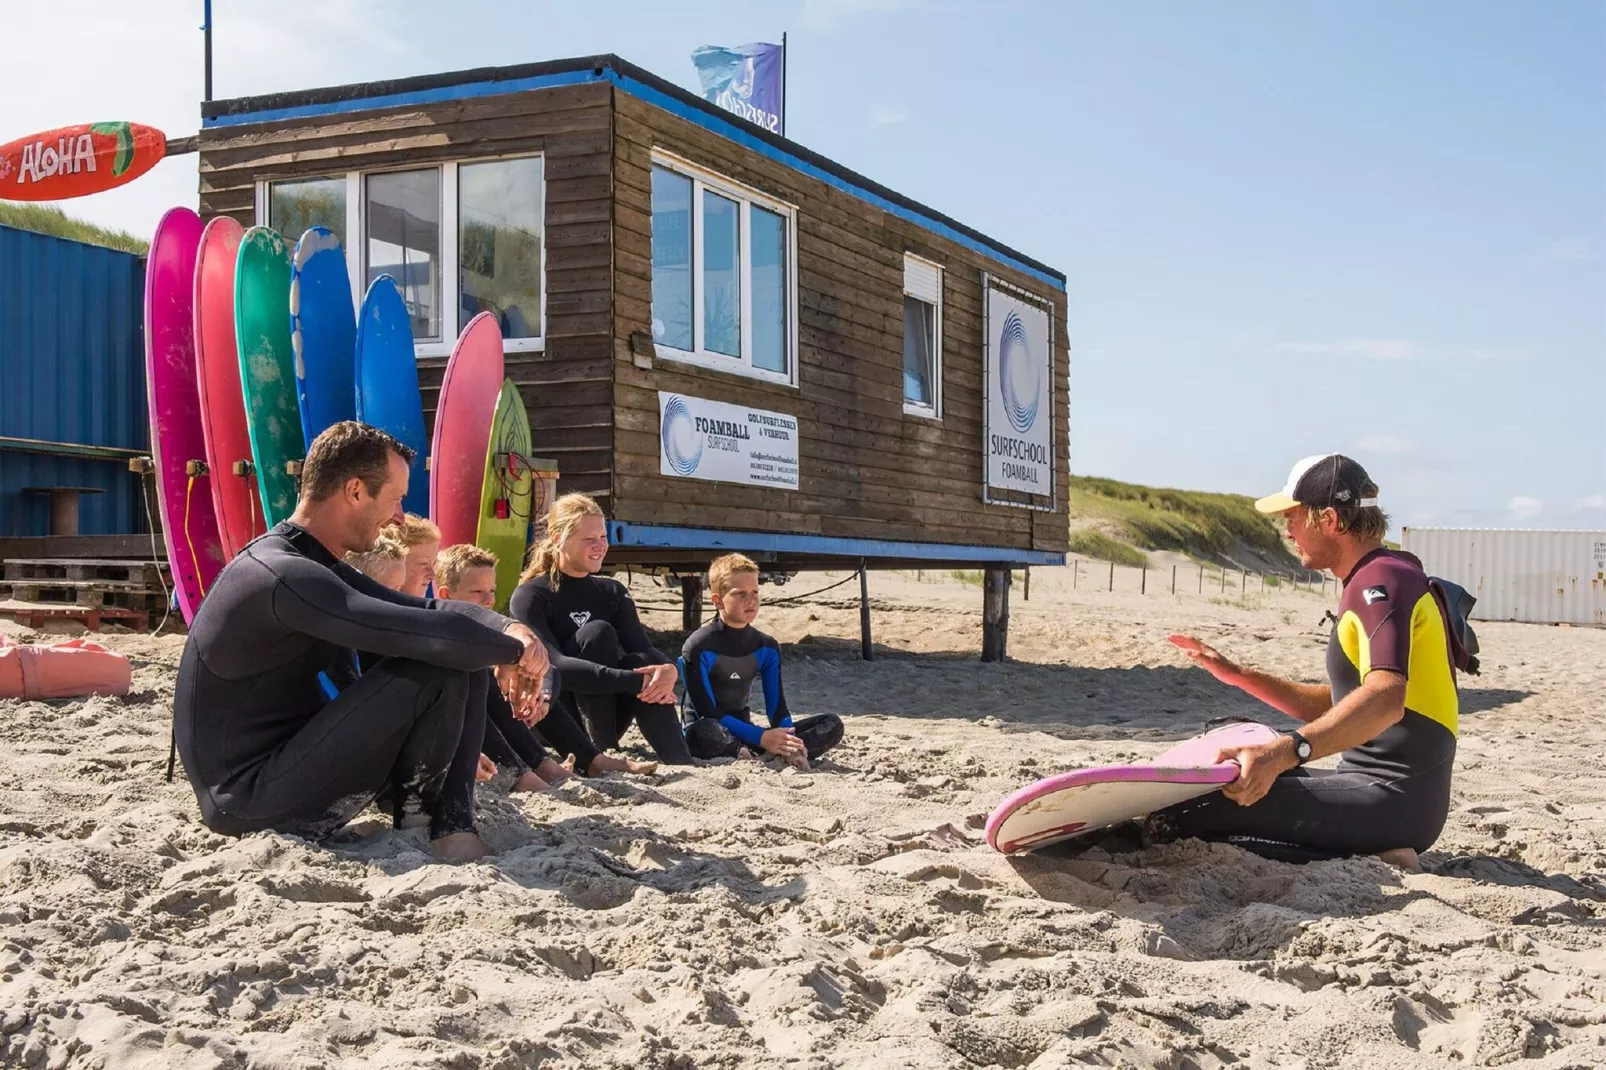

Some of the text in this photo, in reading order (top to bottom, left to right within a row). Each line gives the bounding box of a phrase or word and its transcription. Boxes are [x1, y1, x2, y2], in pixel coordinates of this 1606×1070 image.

[16, 133, 97, 184] ALOHA
[694, 416, 751, 440] FOAMBALL
[763, 428, 790, 441] VERHUUR
[707, 434, 740, 453] SURFSCHOOL
[991, 434, 1047, 465] SURFSCHOOL
[1001, 461, 1038, 484] FOAMBALL
